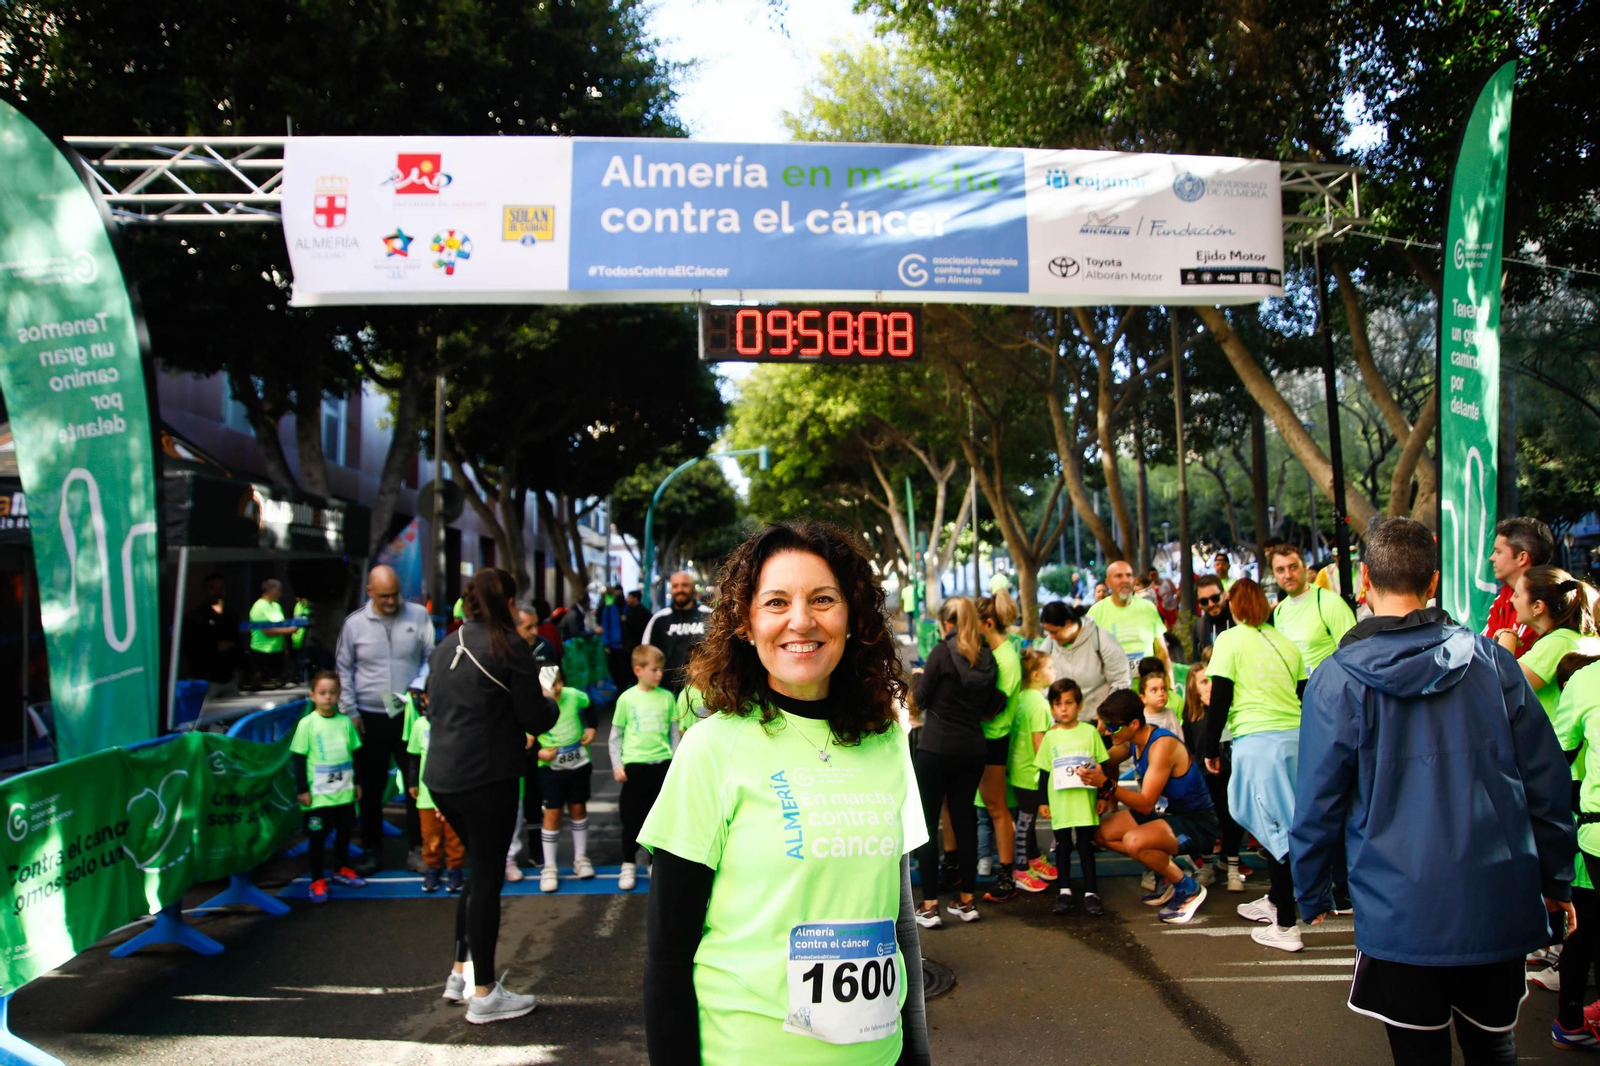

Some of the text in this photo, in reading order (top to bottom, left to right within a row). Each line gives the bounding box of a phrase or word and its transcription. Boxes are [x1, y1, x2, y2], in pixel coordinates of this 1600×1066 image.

[601, 154, 999, 193] Almería en marcha
[1075, 173, 1149, 190] cajamar
[1205, 179, 1268, 190] UNIVERSIDAD
[600, 200, 951, 237] contra el cáncer
[1150, 219, 1236, 236] Fundación
[295, 235, 359, 249] ALMERÍA
[932, 256, 1018, 267] asociación española
[1085, 256, 1122, 268] Toyota
[1196, 250, 1266, 264] Ejido Motor
[588, 265, 729, 277] #TodosContraElCáncer
[934, 266, 1001, 275] contra el cáncer
[1085, 270, 1163, 281] Alborán Motor
[934, 275, 982, 285] en Almería
[1450, 375, 1464, 393] por
[1450, 396, 1480, 421] delante
[667, 622, 704, 636] PUMA
[327, 771, 343, 784] 24
[801, 790, 897, 807] En marcha
[770, 770, 804, 860] ALMERÍA
[808, 807, 880, 827] contra
[1014, 810, 1034, 866] STITCH
[68, 835, 82, 860] el
[13, 876, 62, 916] omos
[65, 857, 97, 888] solo
[795, 927, 834, 937] Almería
[795, 938, 870, 949] contra el cáncer
[802, 957, 896, 1004] 1600
